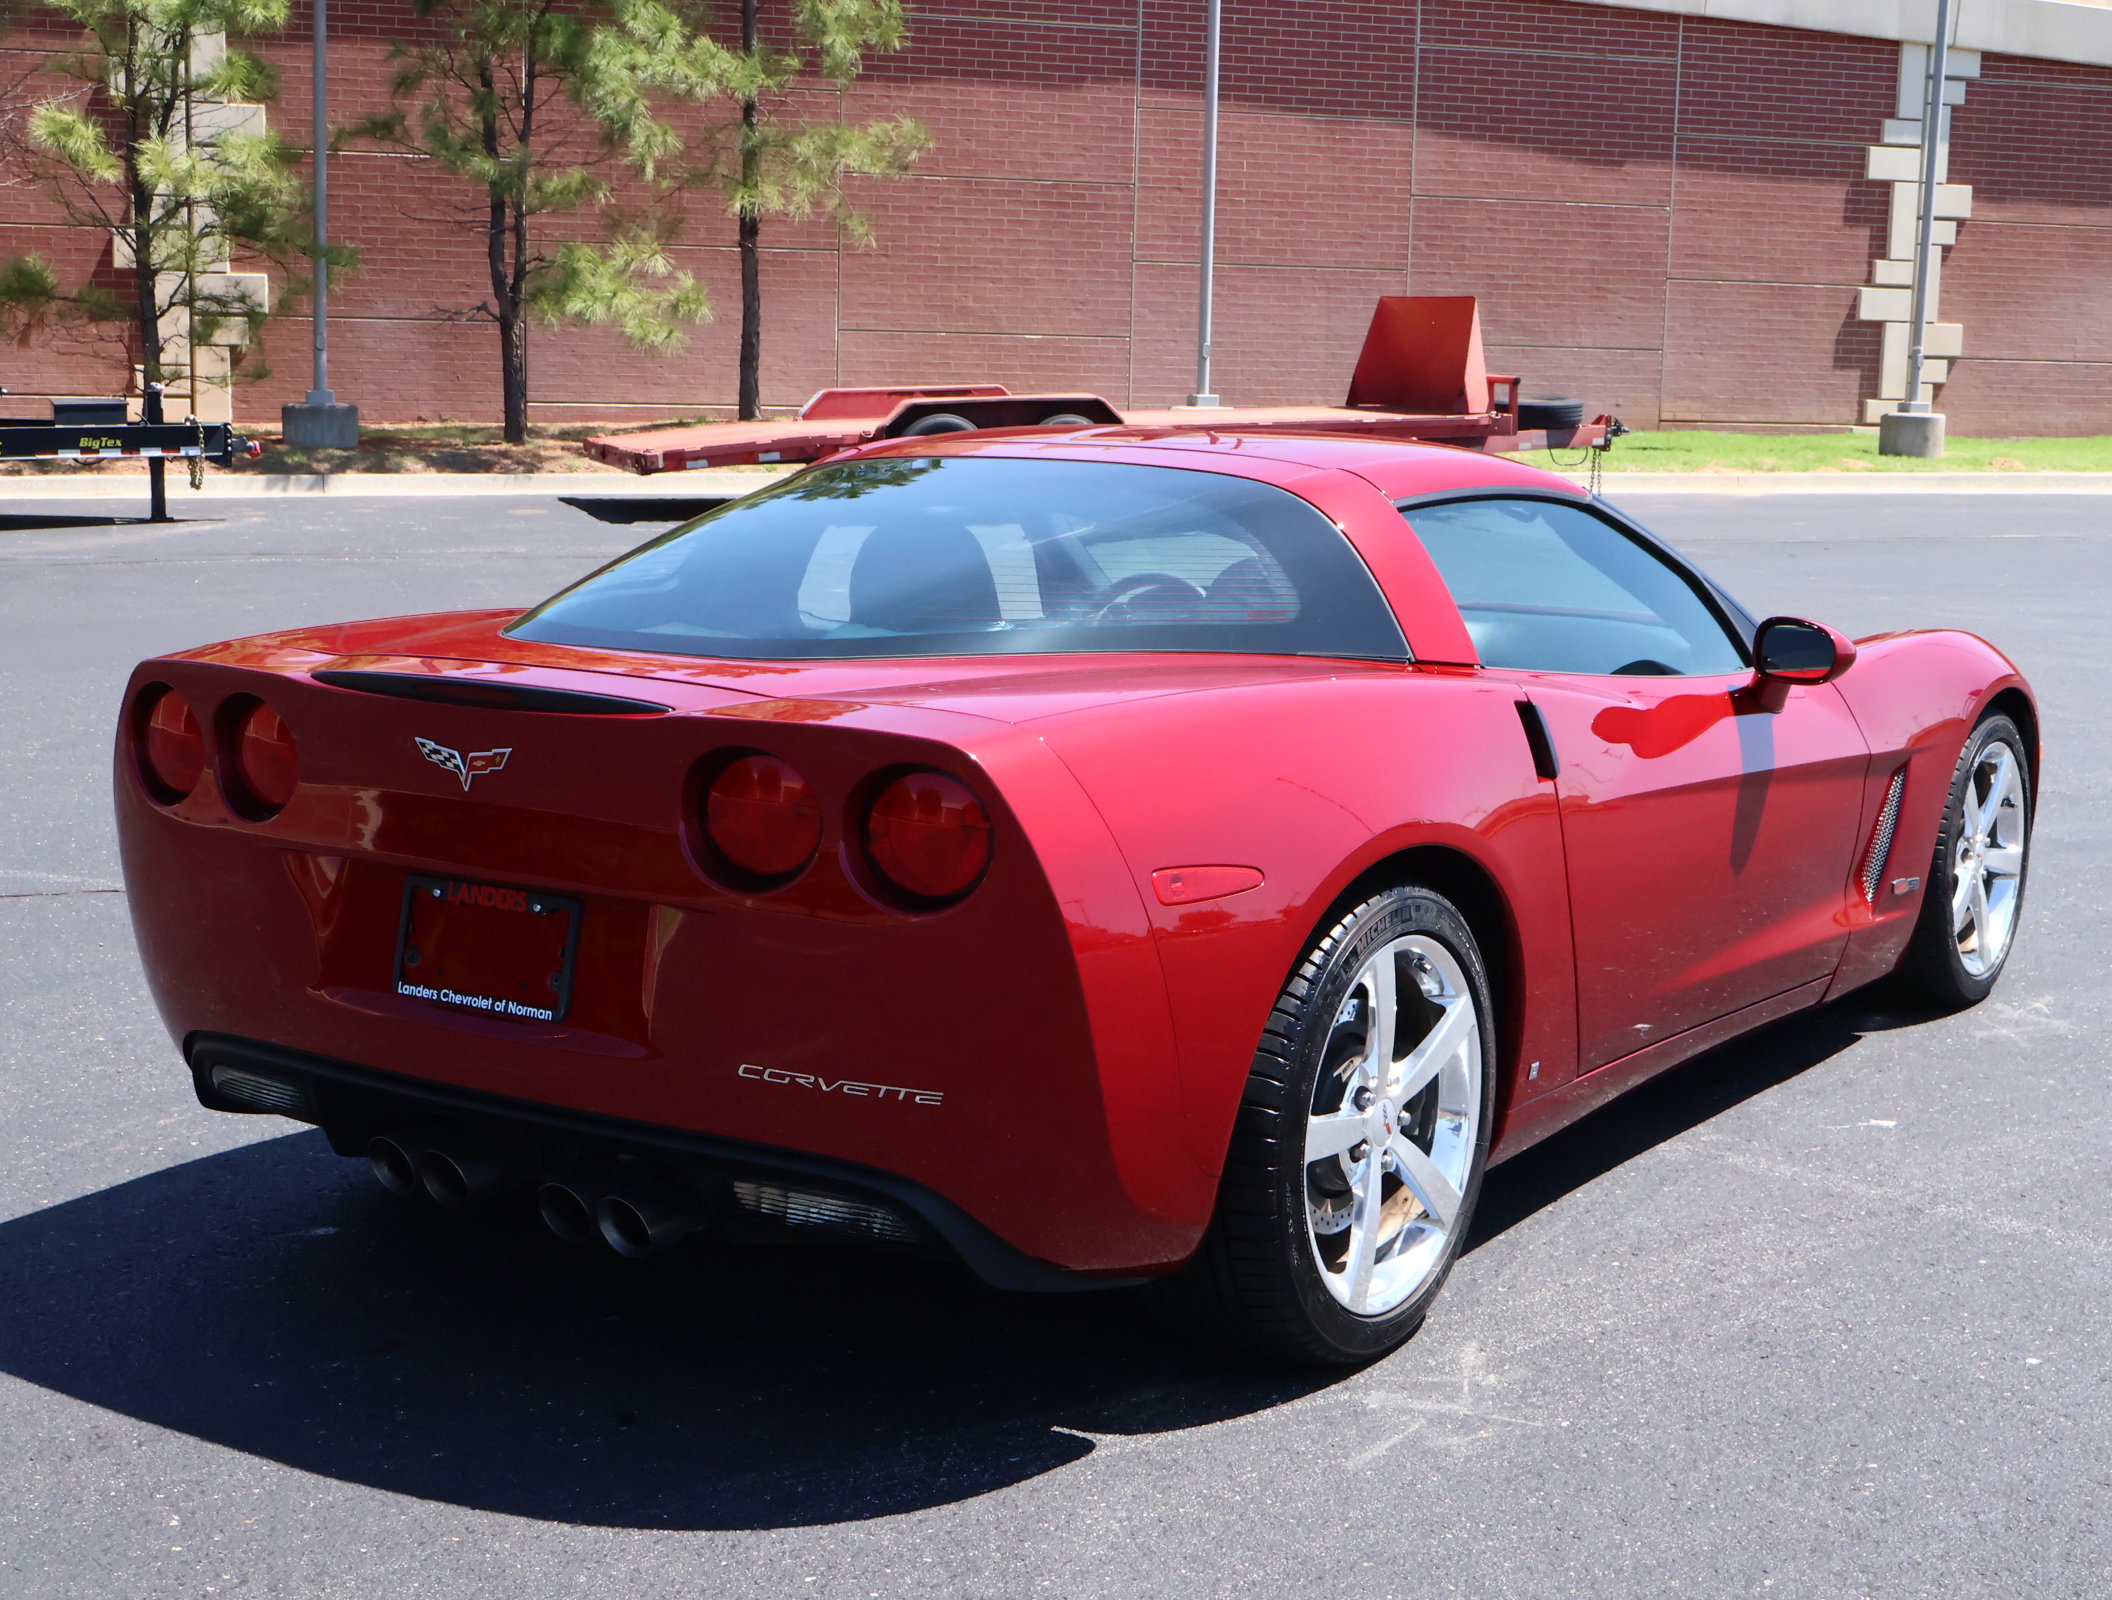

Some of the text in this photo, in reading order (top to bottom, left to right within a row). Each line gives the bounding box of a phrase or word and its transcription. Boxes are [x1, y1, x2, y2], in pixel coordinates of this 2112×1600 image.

[79, 437, 122, 450] BigTex
[447, 882, 528, 913] LANDERS
[398, 981, 552, 1021] Landers Chevrolet of Norman
[738, 1064, 944, 1106] CORVETTE
